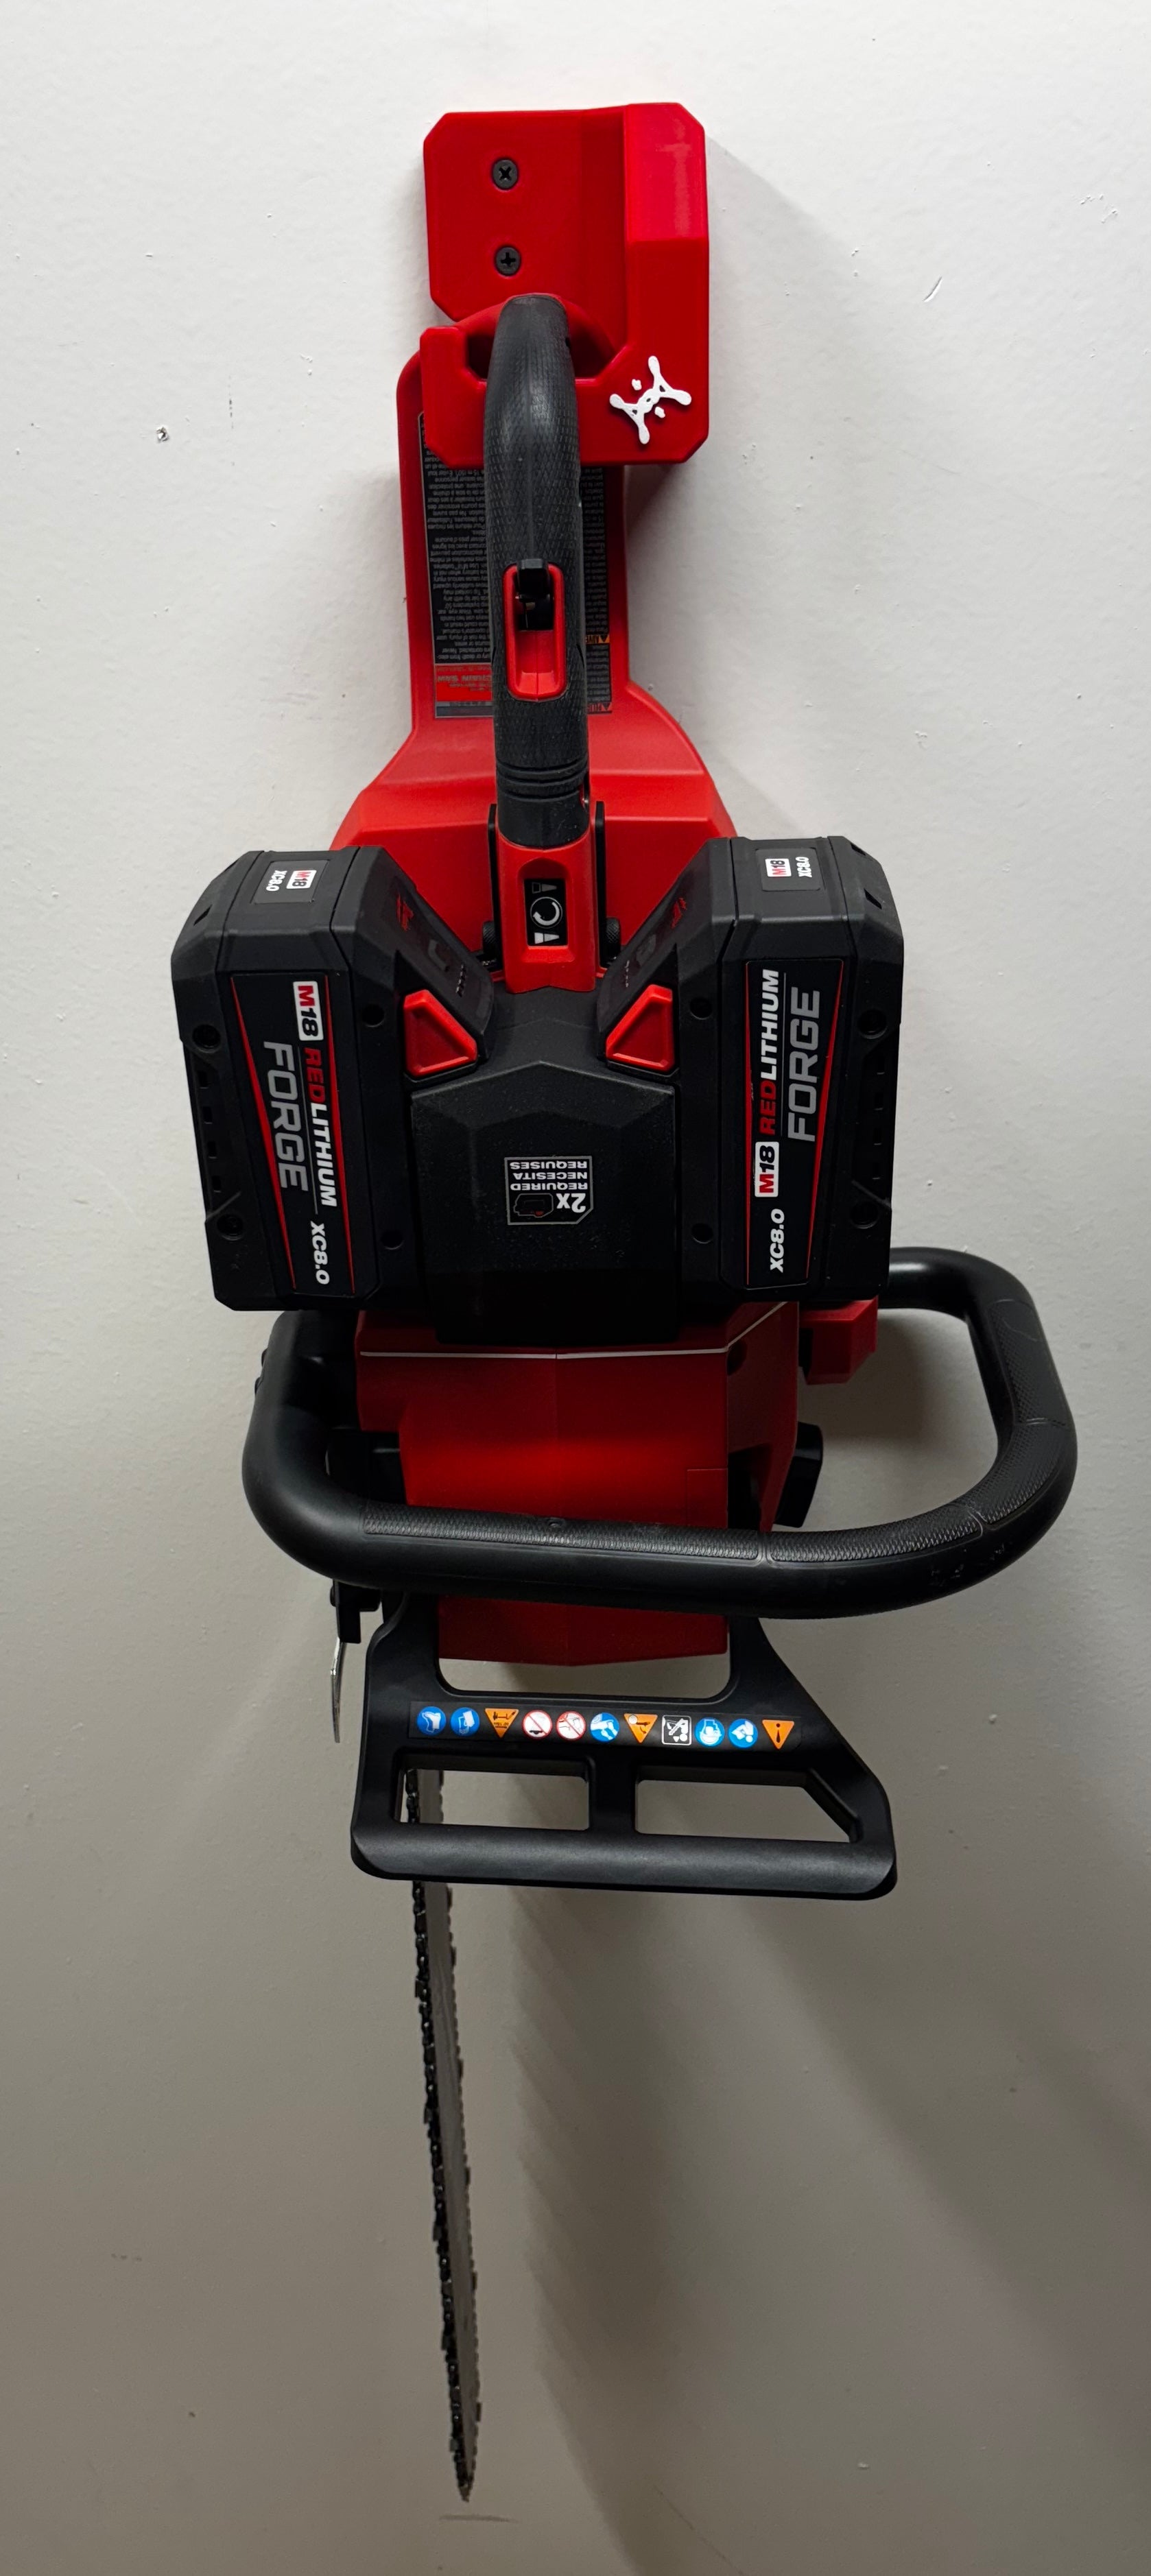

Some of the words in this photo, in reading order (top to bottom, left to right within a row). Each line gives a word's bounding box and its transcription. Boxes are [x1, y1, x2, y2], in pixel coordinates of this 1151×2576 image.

[266, 870, 287, 892] XC8.0
[292, 871, 311, 887] M18
[770, 860, 787, 875] M18
[795, 856, 812, 878] XC8.0
[297, 984, 320, 1038] M18
[759, 969, 779, 1136] REDLITHIUM
[787, 986, 820, 1143] FORGE
[263, 1040, 309, 1192] FORGE
[304, 1047, 337, 1208] REDLITHIUM
[510, 1160, 587, 1169] REQUISES
[510, 1182, 588, 1191] REQUIRED
[512, 1171, 588, 1180] NECESITA
[758, 1145, 776, 1194] M18
[309, 1221, 330, 1285] XC8.0
[770, 1208, 785, 1274] XC8.0
